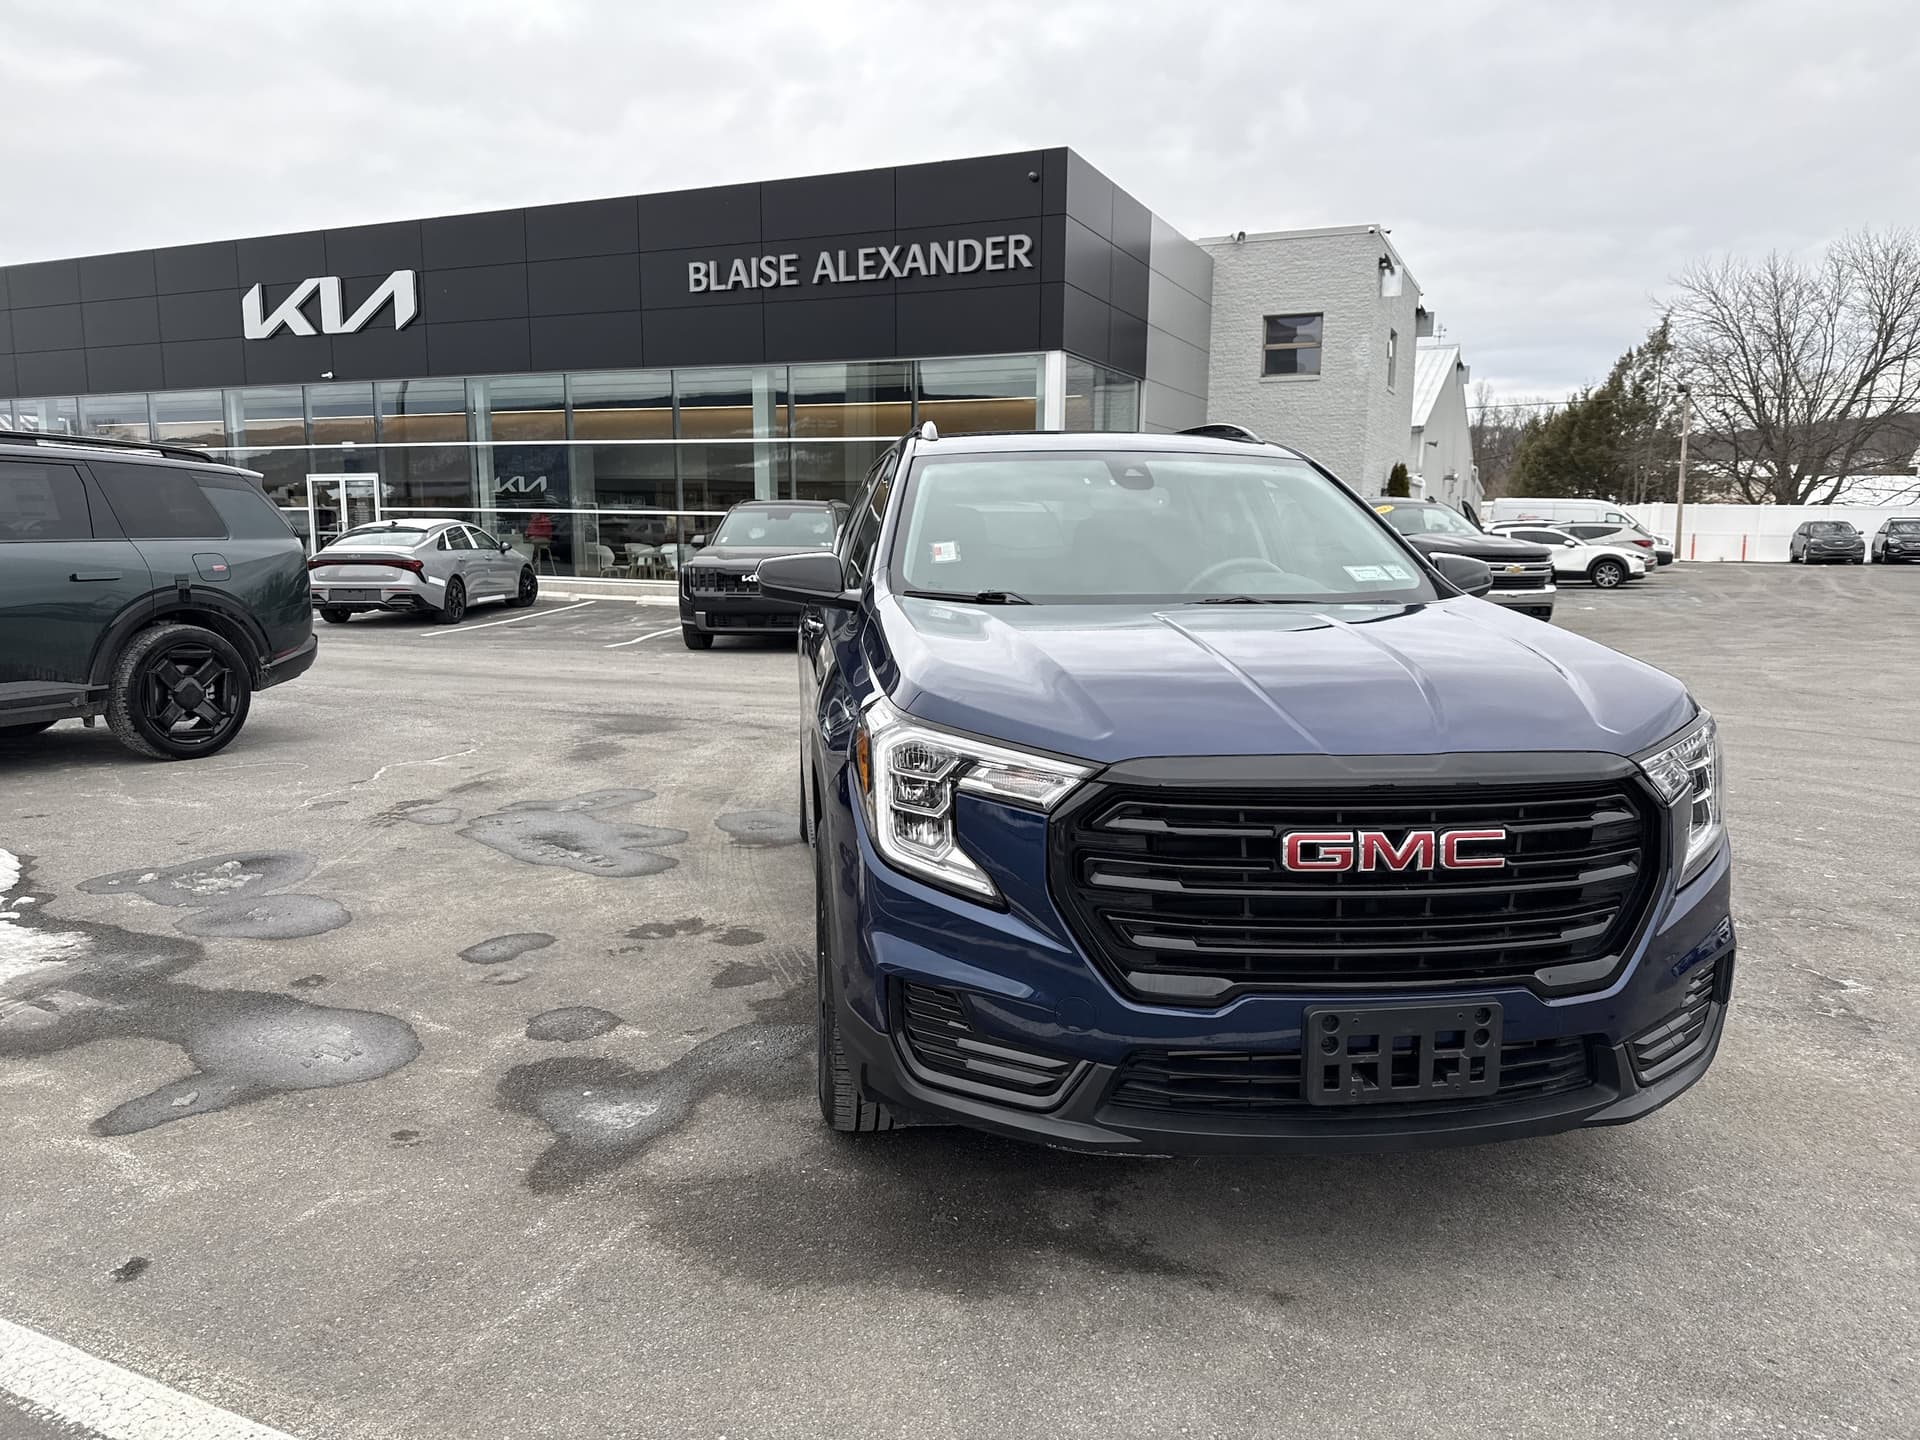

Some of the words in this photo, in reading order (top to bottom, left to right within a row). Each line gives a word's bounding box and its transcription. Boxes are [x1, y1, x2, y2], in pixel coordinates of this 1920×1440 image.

[688, 253, 799, 293] BLAISE
[812, 233, 1033, 284] ALEXANDER
[242, 269, 417, 340] KIA
[493, 475, 547, 493] KIA
[1282, 829, 1506, 872] GMC
